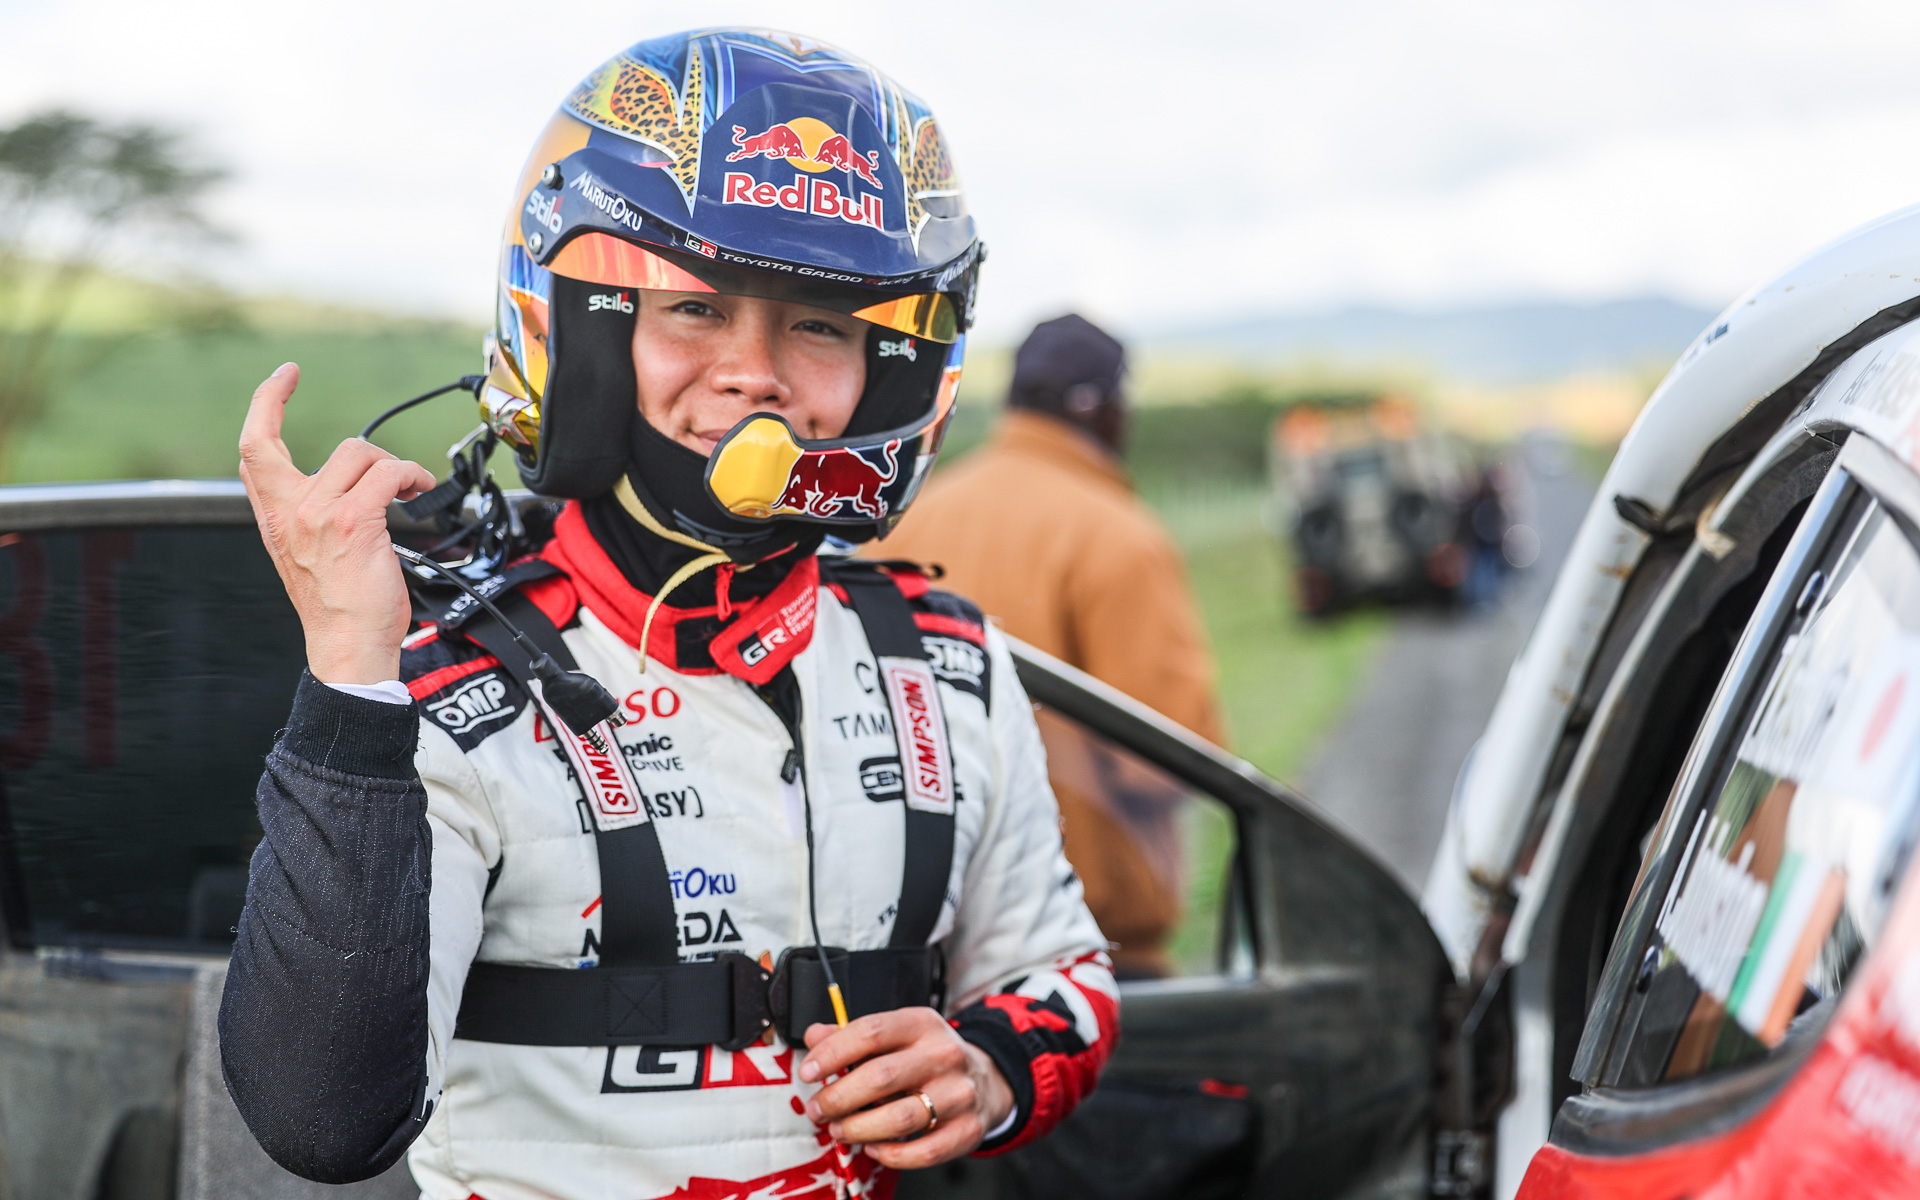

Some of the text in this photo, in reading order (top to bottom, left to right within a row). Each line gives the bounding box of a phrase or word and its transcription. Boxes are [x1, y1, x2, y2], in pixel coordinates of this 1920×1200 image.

[725, 173, 883, 230] Red Bull
[687, 238, 716, 257] GR
[721, 252, 793, 272] TOYOTA
[797, 267, 863, 283] GAZOO
[742, 627, 788, 667] GR
[436, 680, 506, 727] OMP
[902, 678, 941, 793] SIMPSON
